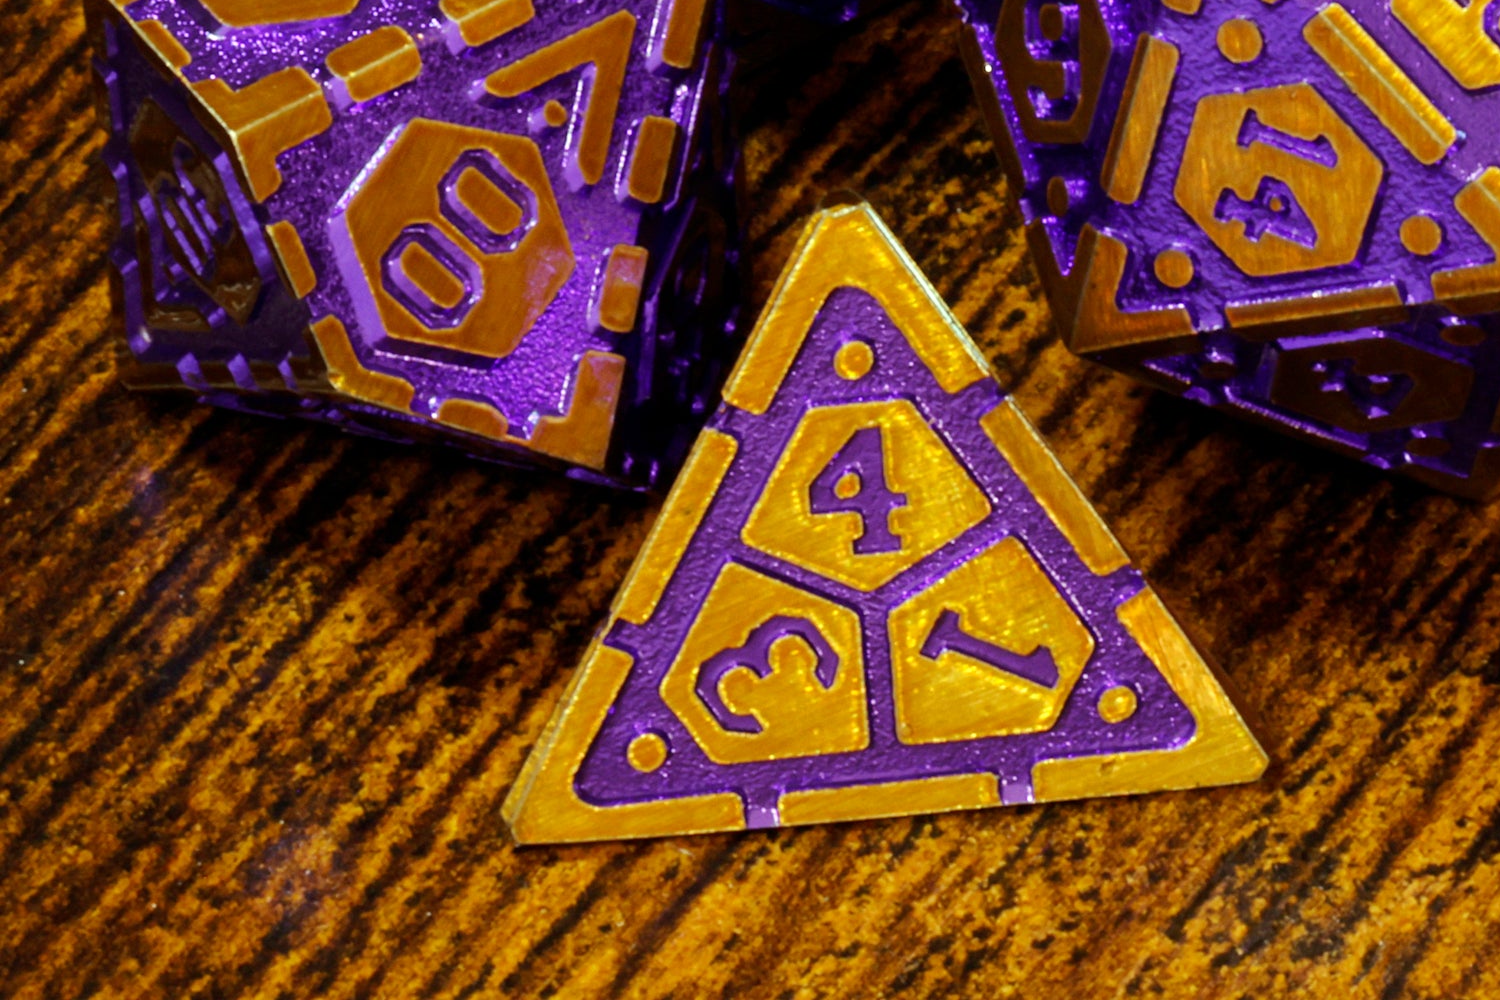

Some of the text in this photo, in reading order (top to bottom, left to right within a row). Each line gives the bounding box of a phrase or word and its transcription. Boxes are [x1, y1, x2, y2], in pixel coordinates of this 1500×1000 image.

[379, 146, 541, 331] 00
[1213, 107, 1339, 251] 14
[807, 424, 908, 557] 4
[693, 613, 842, 736] 3
[918, 607, 1061, 691] 1
